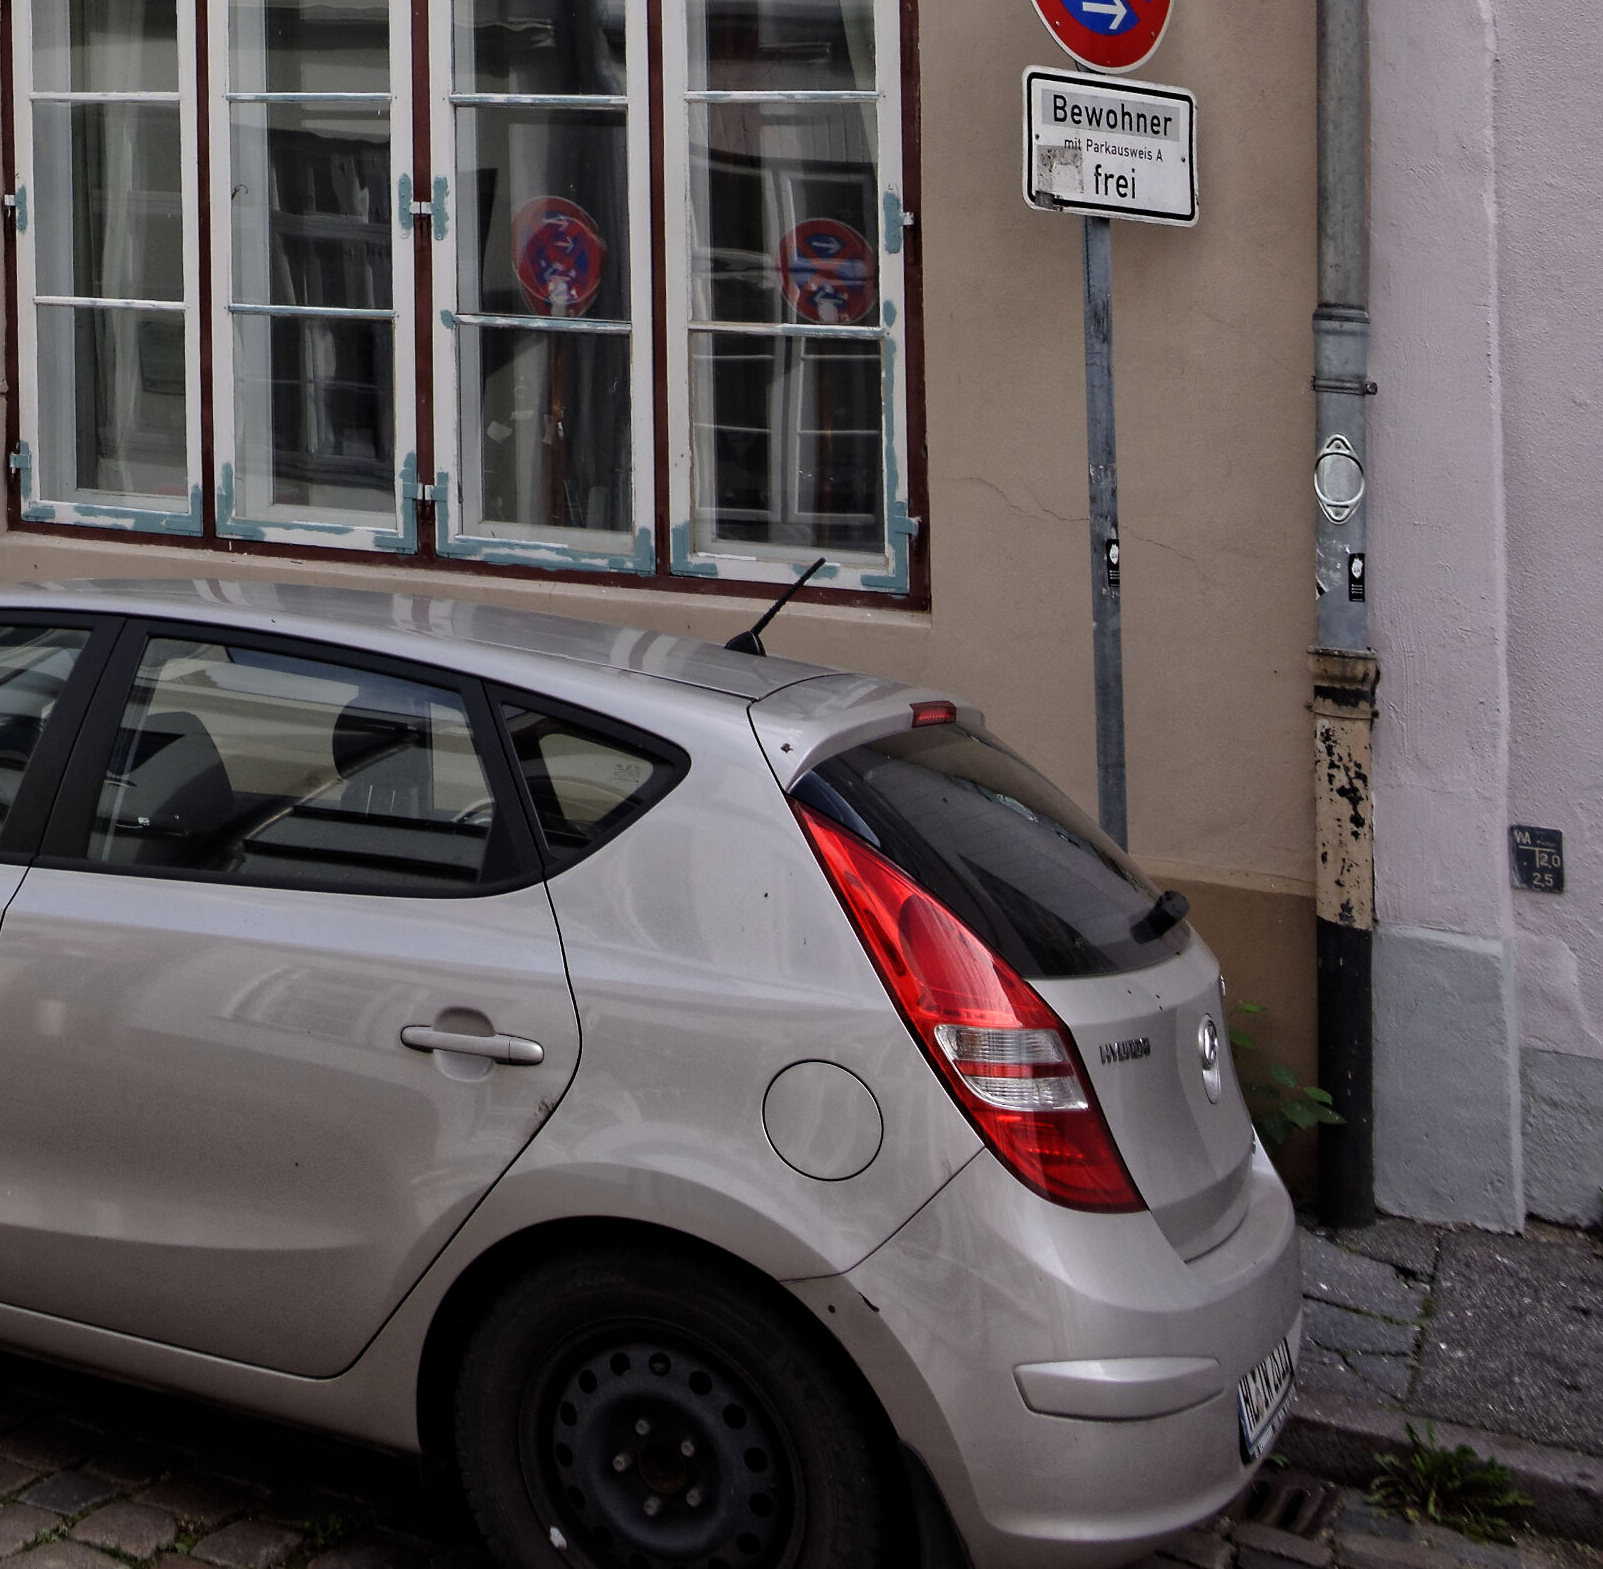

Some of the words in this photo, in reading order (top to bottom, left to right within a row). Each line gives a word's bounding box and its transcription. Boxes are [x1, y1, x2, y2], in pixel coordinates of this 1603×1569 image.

[1053, 94, 1172, 136] Bewohner
[1064, 137, 1082, 151] mit
[1086, 138, 1153, 161] Parkausweis
[1156, 149, 1164, 162] A
[1094, 164, 1136, 199] frei
[1532, 872, 1554, 887] 2,5
